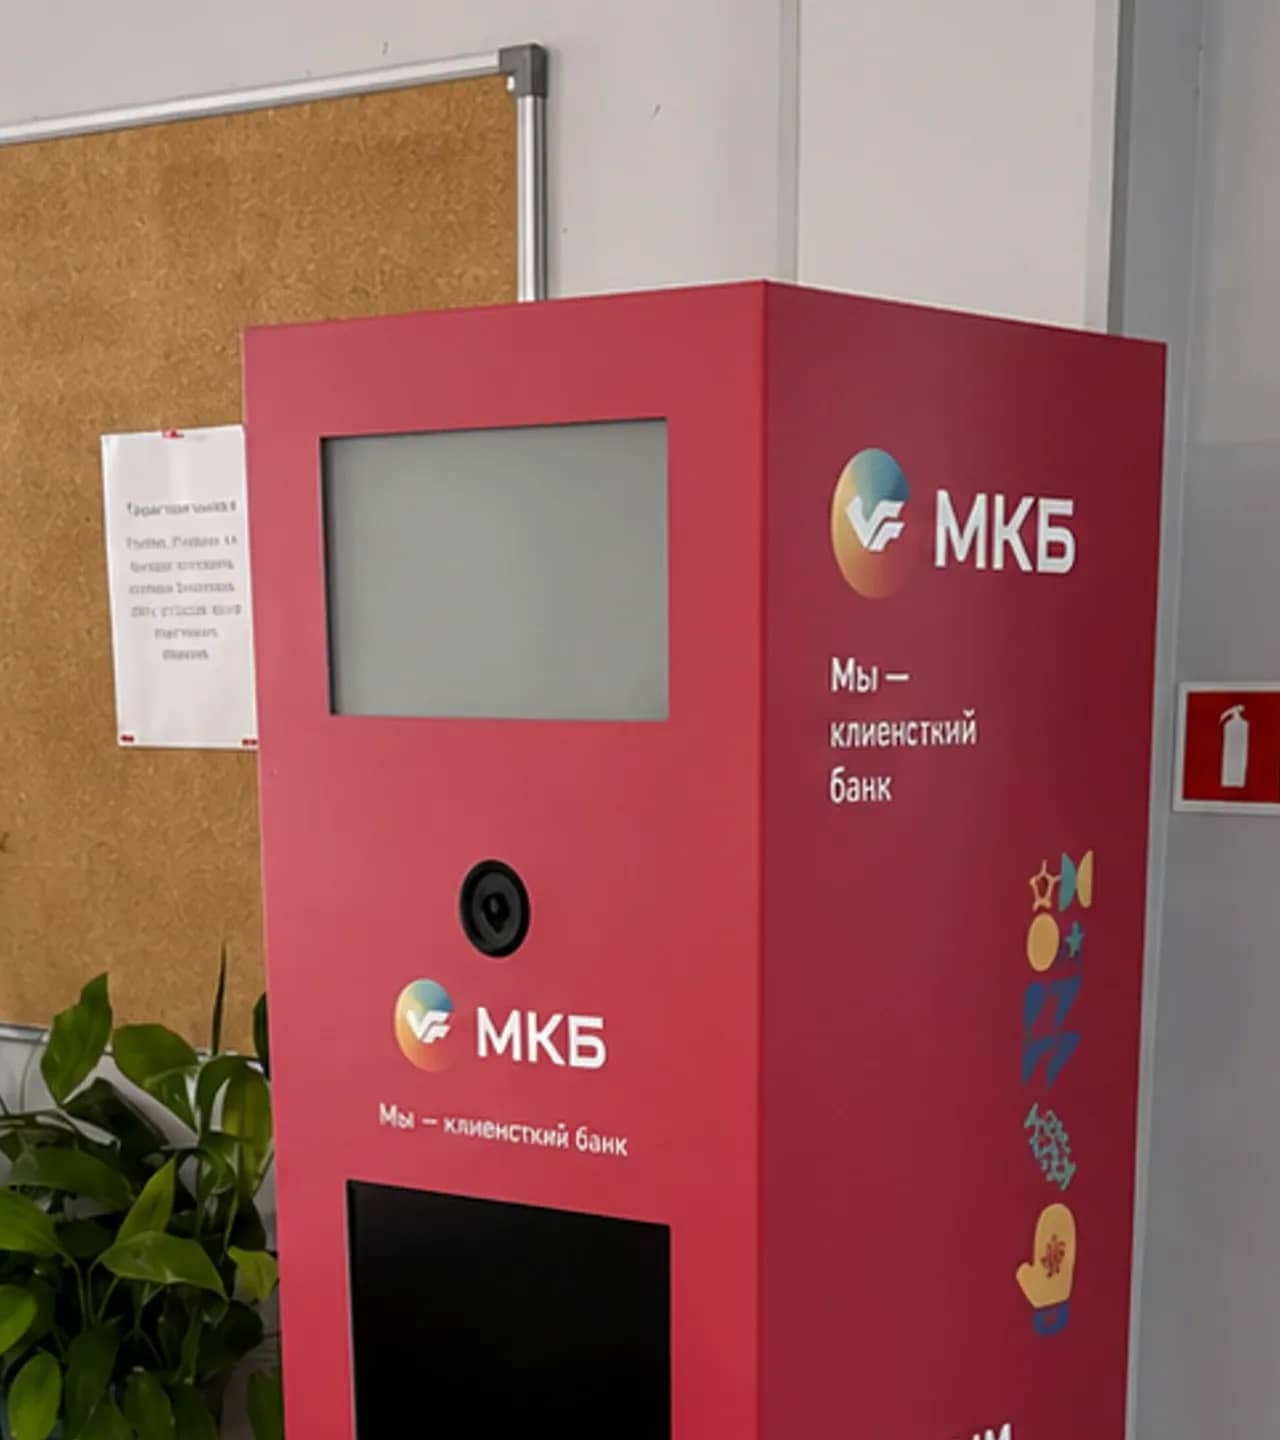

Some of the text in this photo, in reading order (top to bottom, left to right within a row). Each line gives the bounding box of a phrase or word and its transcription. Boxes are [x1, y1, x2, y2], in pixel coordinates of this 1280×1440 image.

[934, 488, 1076, 574] МКБ
[830, 656, 879, 693] Мы
[830, 708, 977, 748] клиенсткий
[830, 765, 893, 804] банк
[476, 1006, 607, 1070] МКБ
[378, 1102, 415, 1129] Мы
[443, 1117, 570, 1149] клиенсткий
[574, 1126, 629, 1157] банк
